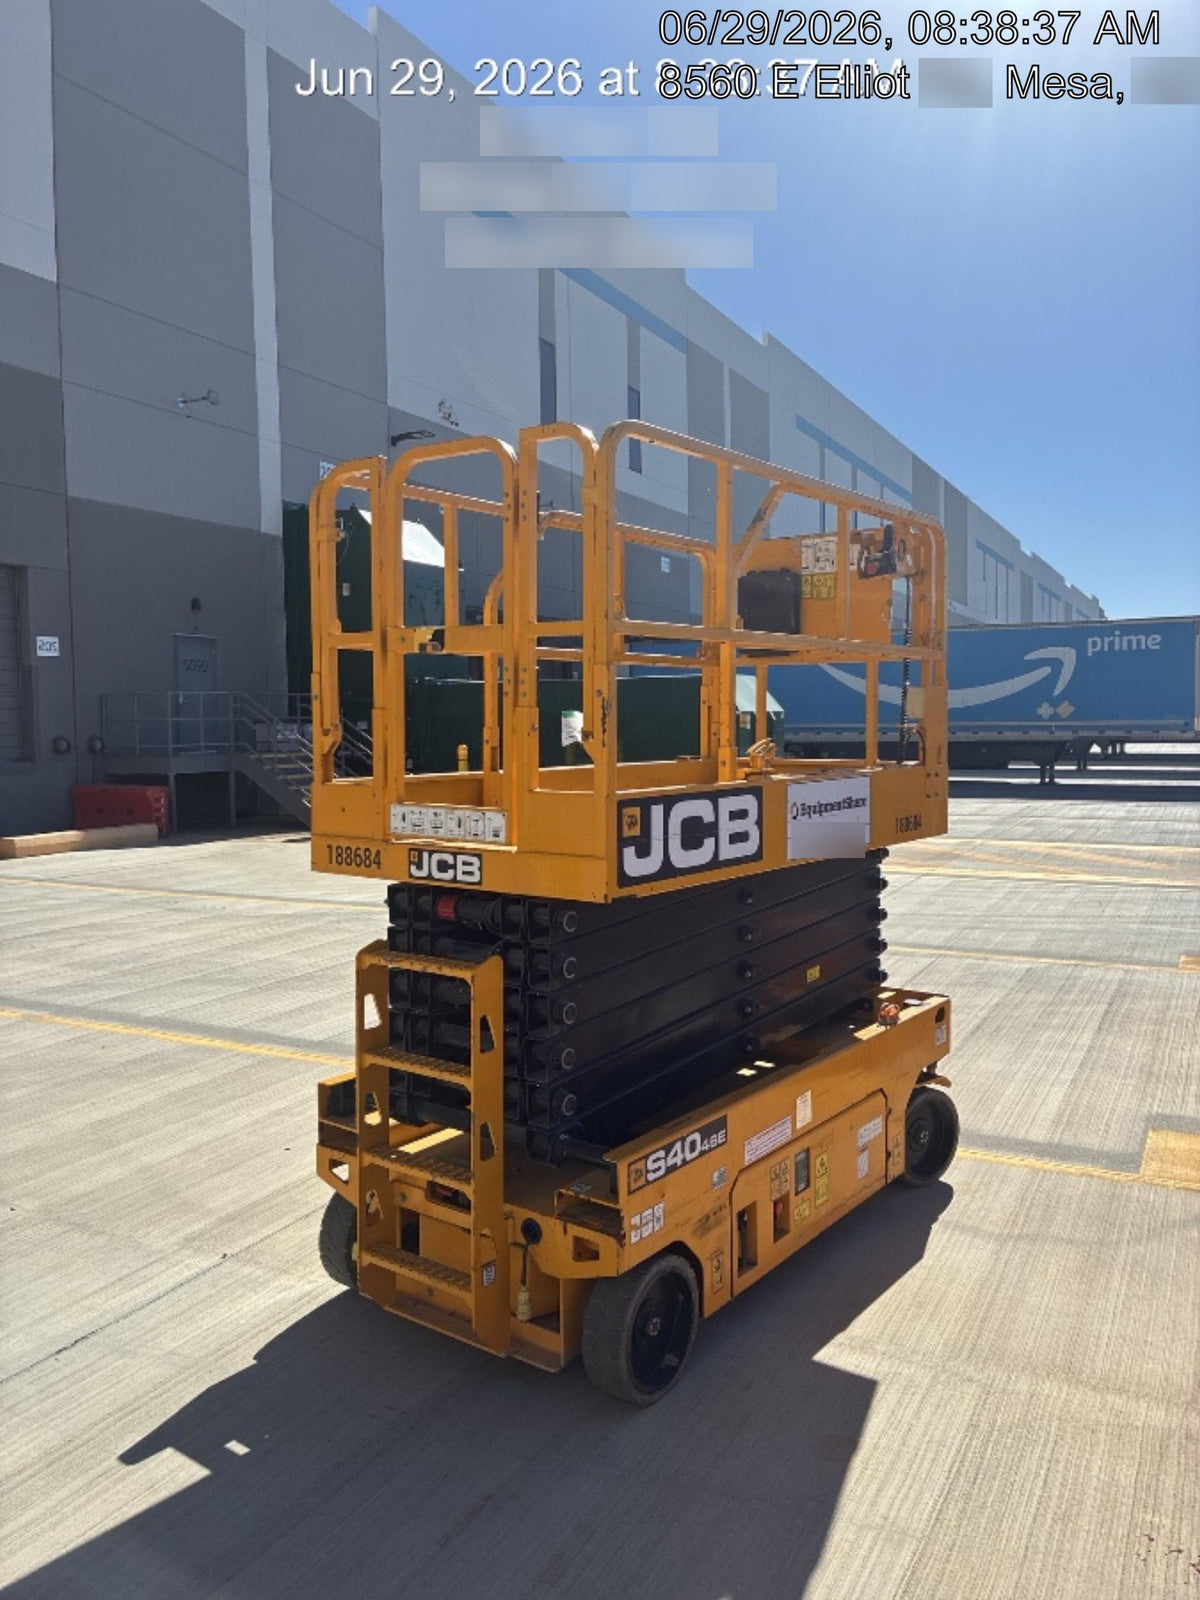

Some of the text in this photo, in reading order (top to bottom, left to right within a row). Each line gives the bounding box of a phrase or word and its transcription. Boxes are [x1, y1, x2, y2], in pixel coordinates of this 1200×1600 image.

[1087, 630, 1162, 657] prime
[623, 794, 760, 877] JCB
[326, 844, 382, 870] 188684
[410, 851, 481, 883] JCB
